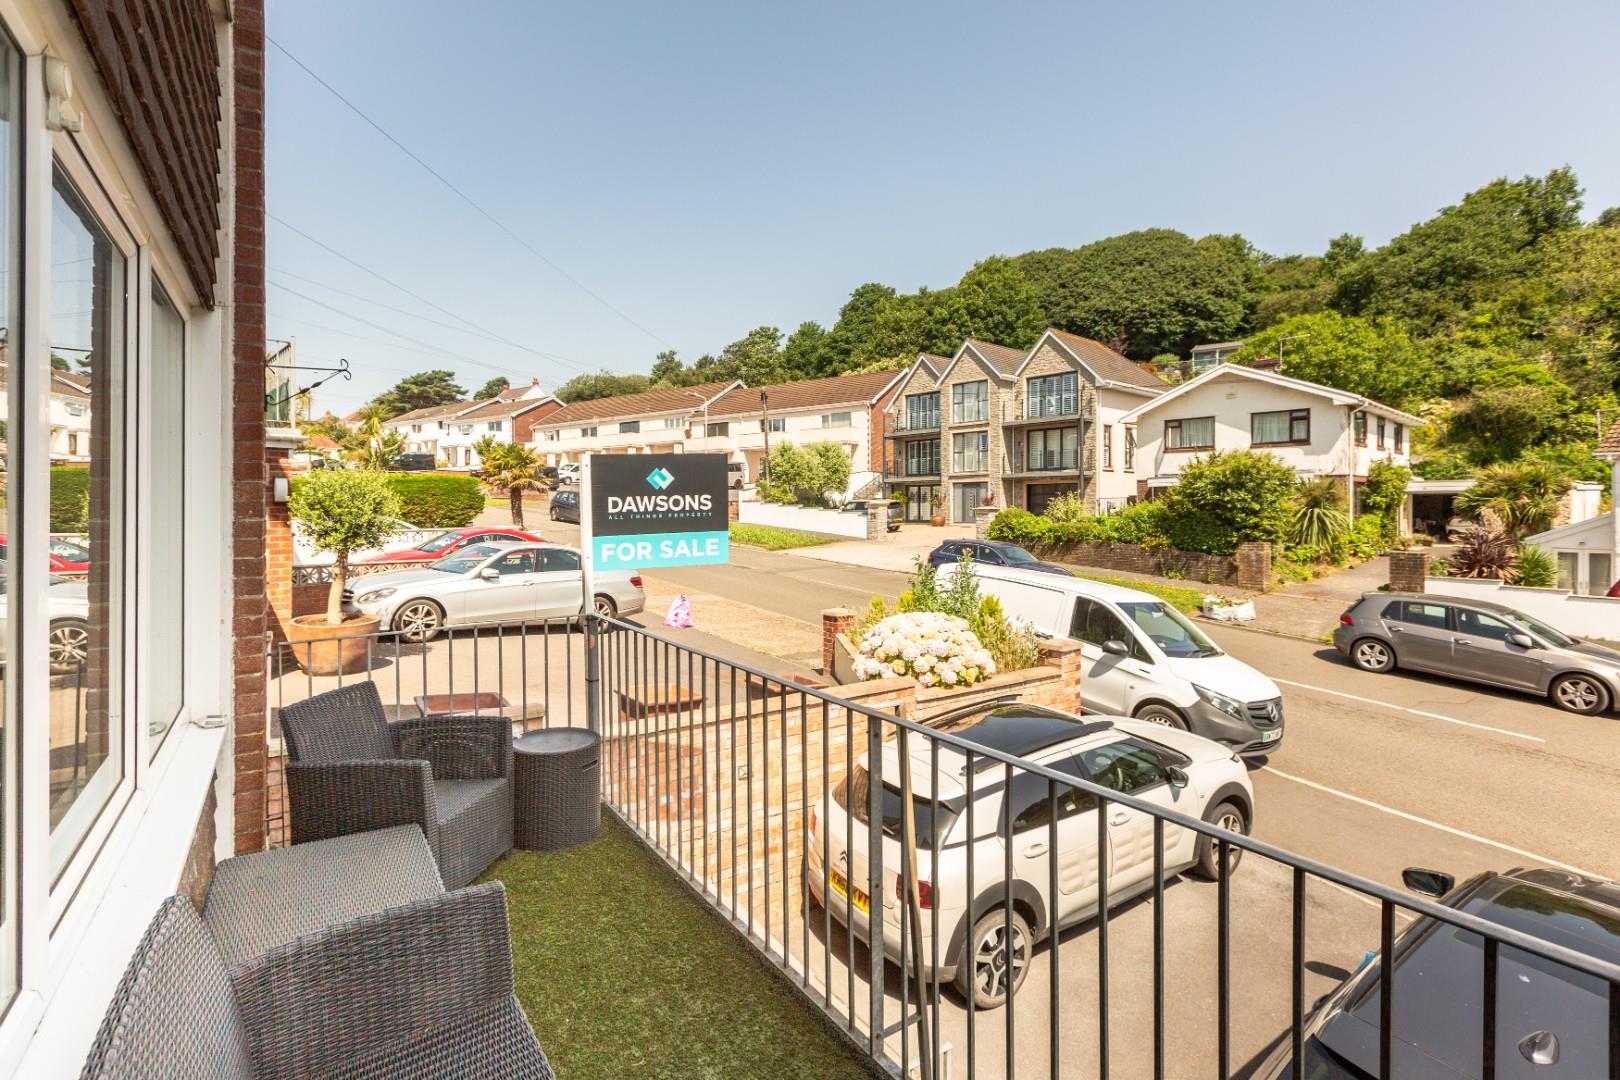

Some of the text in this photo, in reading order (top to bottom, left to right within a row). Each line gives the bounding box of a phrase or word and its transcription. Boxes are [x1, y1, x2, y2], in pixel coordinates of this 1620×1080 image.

[607, 494, 713, 514] DAWSONS
[601, 538, 720, 563] FOR SALE
